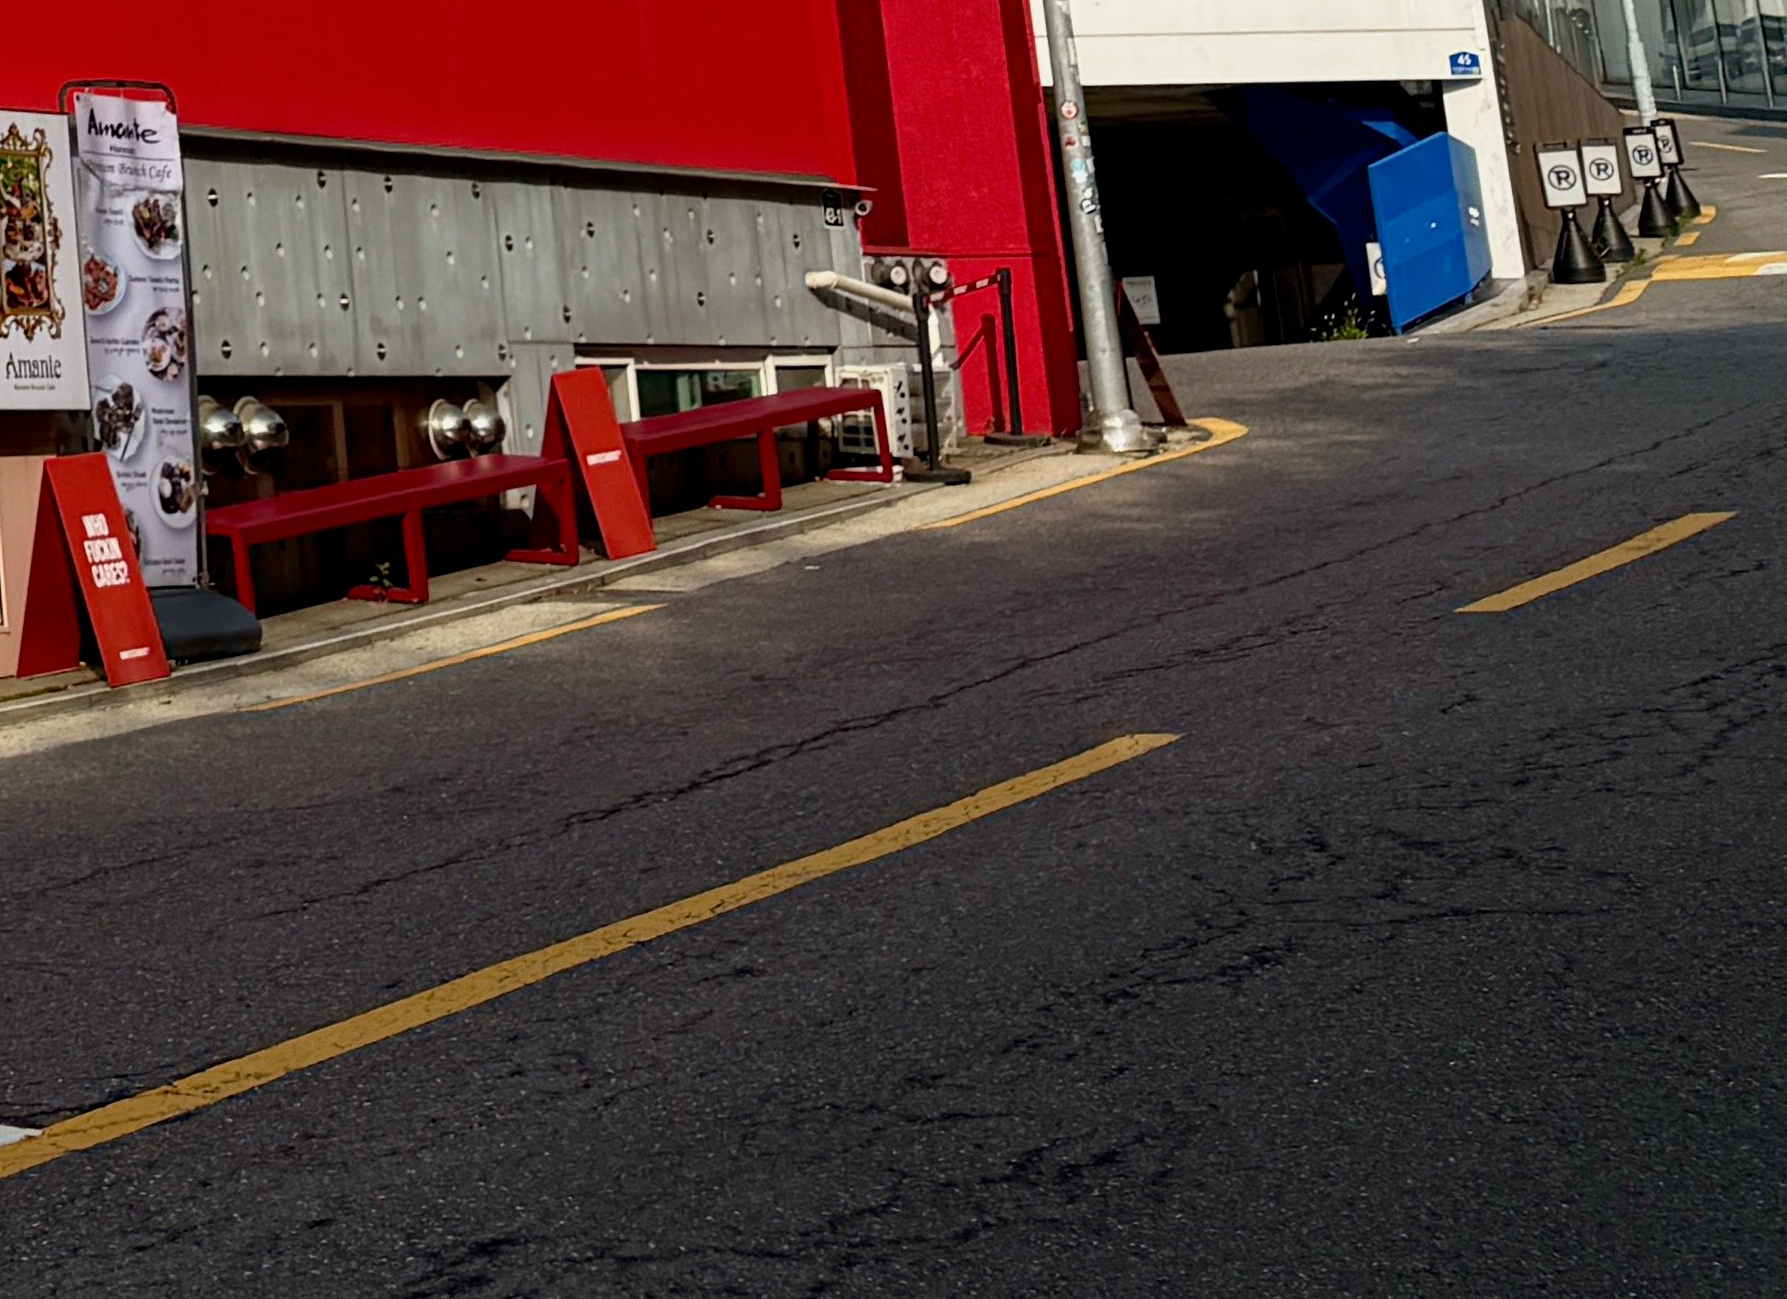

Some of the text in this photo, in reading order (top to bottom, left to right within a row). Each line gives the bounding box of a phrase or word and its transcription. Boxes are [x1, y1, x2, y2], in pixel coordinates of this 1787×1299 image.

[88, 107, 161, 144] Amante
[149, 165, 173, 182] Cafe
[6, 351, 62, 380] Amante
